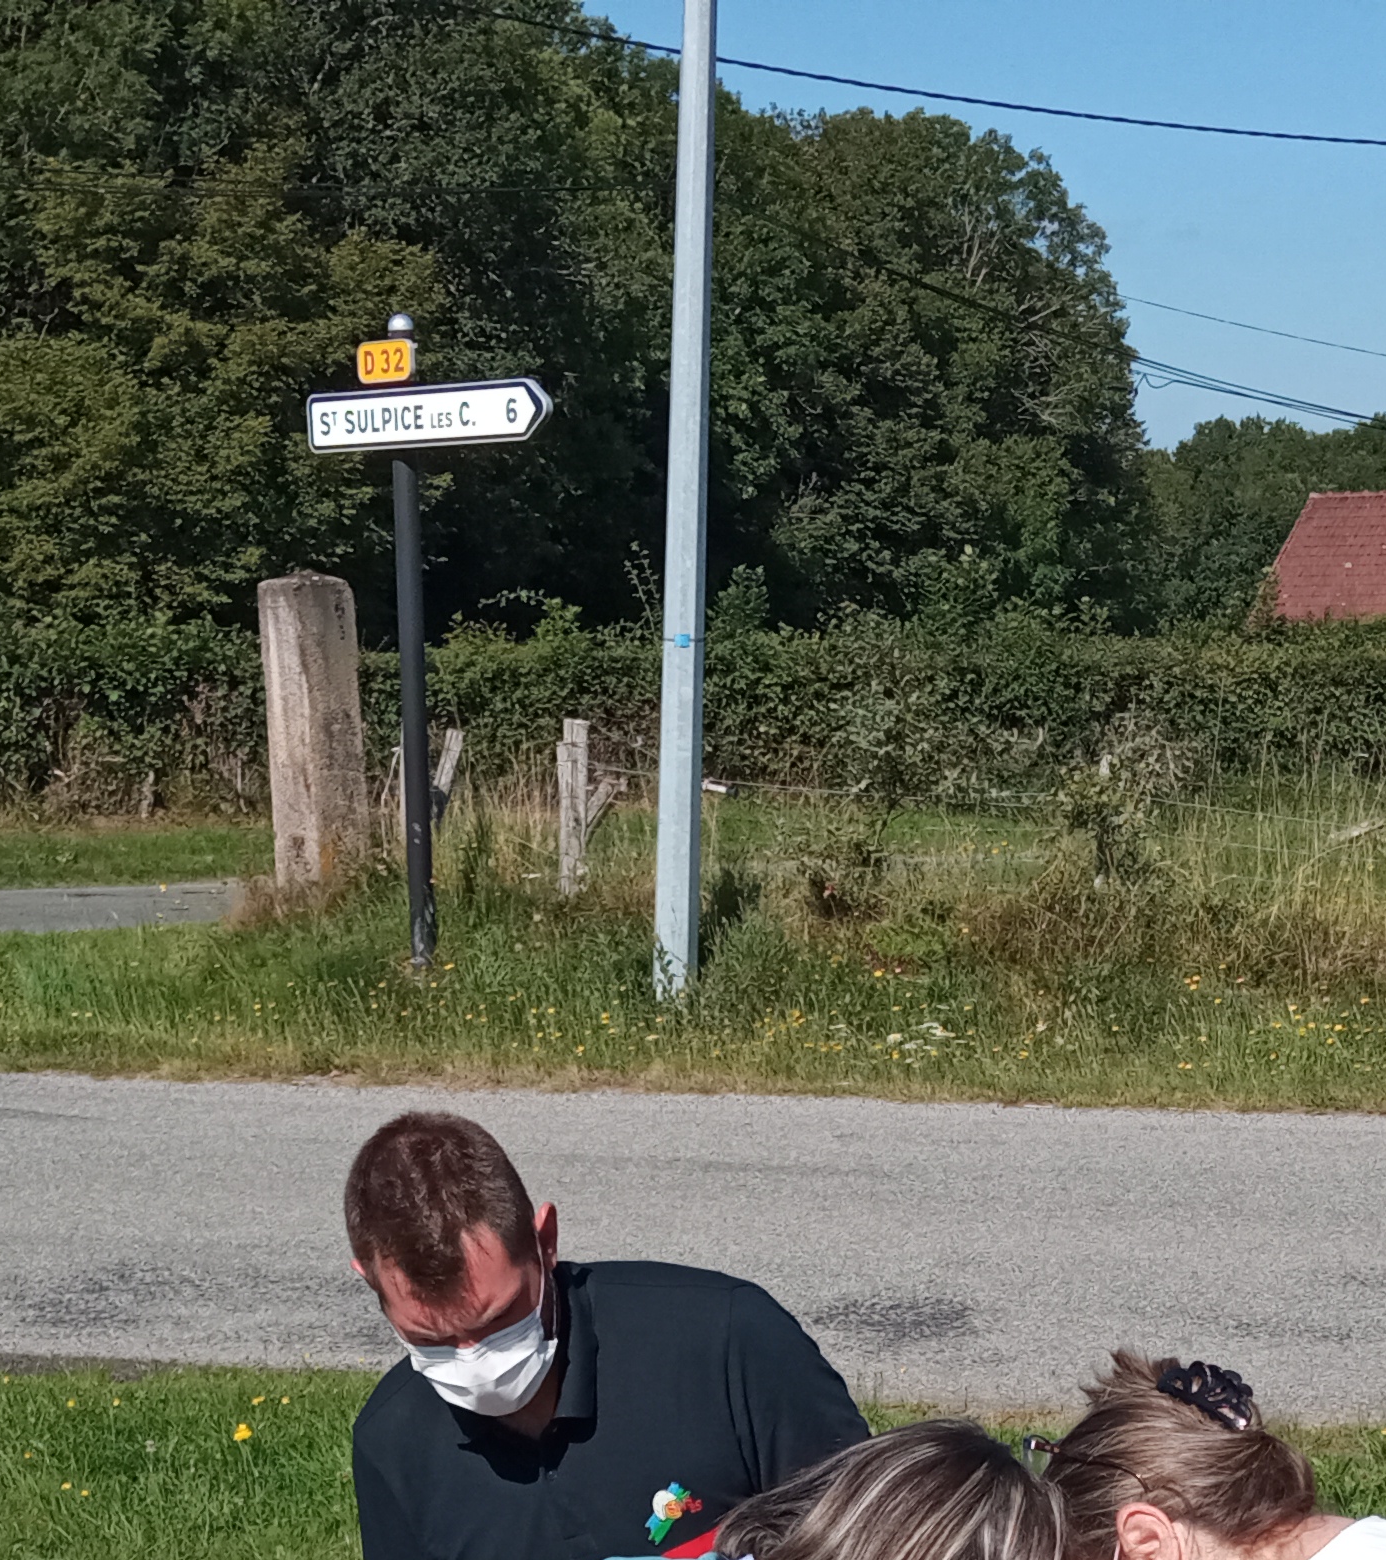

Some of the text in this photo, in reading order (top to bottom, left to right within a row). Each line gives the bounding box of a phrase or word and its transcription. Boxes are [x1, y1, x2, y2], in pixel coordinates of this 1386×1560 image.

[344, 405, 424, 434] SULPICE
[430, 412, 453, 429] LES
[459, 402, 476, 426] C.
[506, 398, 517, 423] 6
